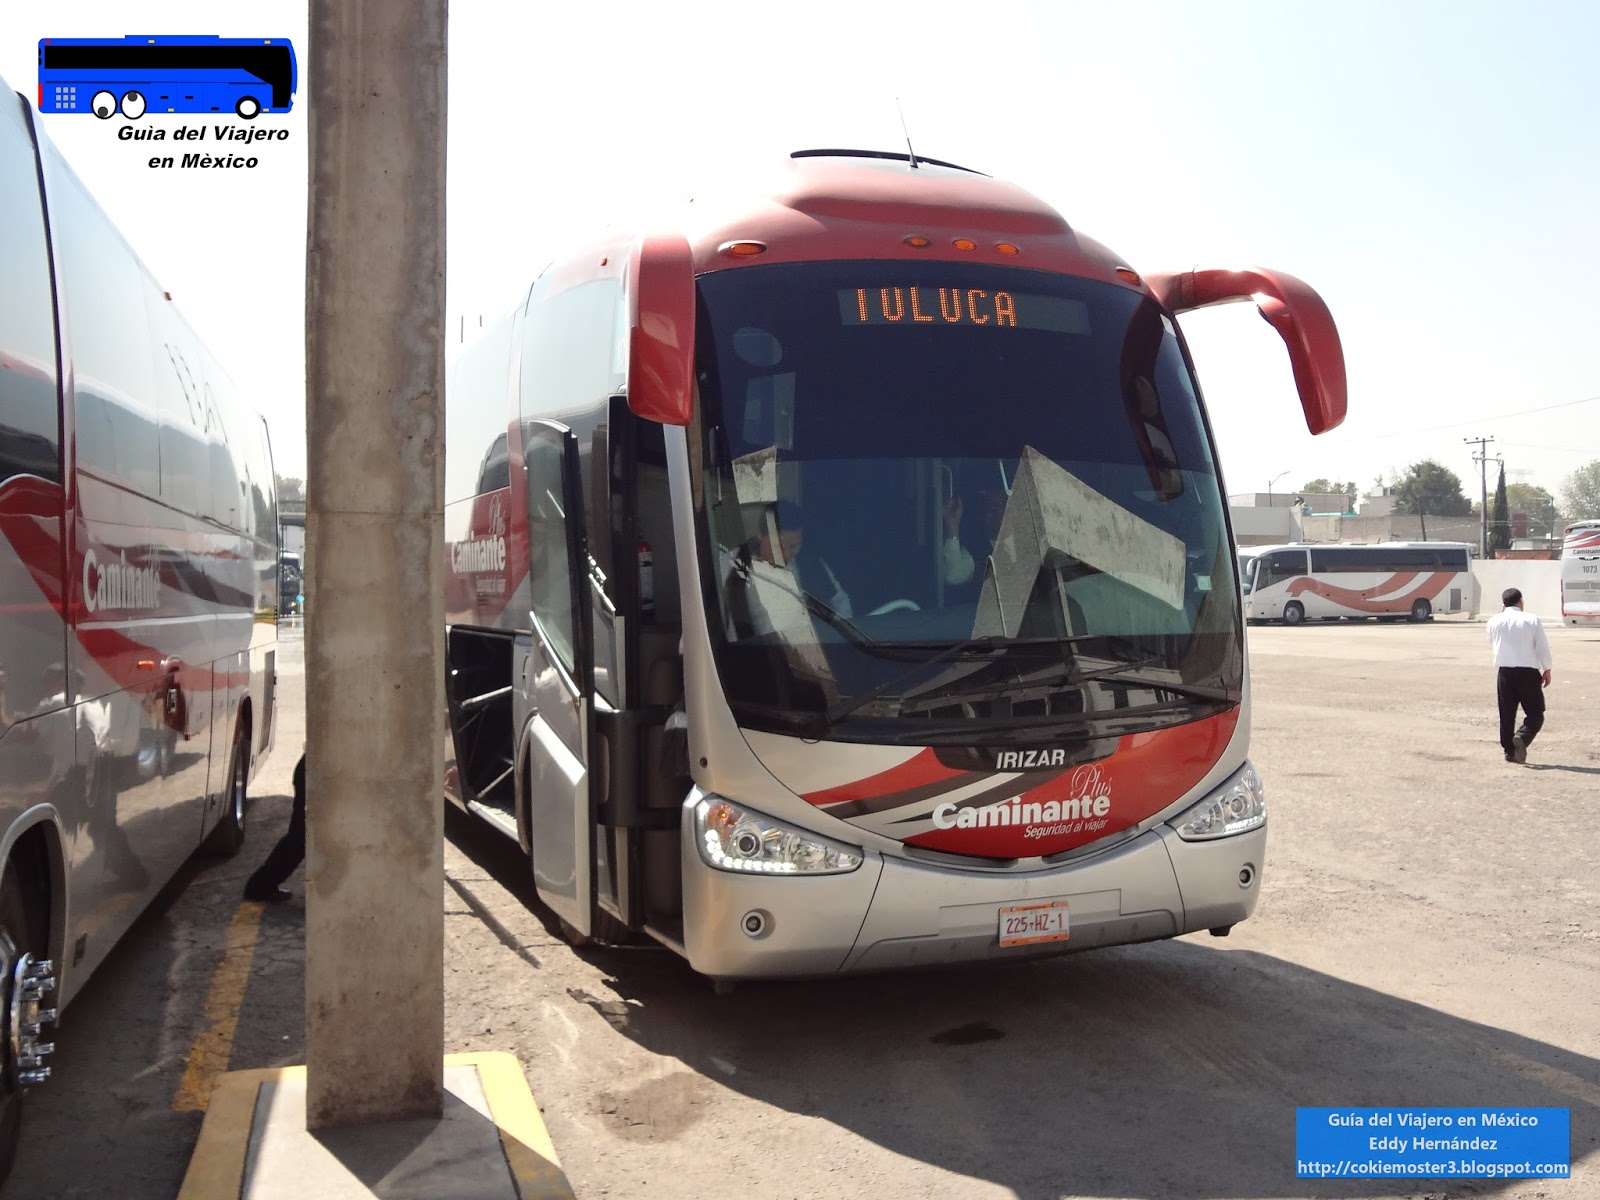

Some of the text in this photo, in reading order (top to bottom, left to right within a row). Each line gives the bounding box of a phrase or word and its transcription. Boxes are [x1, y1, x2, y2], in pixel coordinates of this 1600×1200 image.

[451, 530, 506, 573] Caminante
[83, 549, 161, 613] Caminante
[1582, 565, 1598, 574] 1073
[996, 749, 1066, 770] IRIZAR
[1069, 763, 1112, 799] Plus
[932, 795, 1111, 830] Caminante
[1024, 817, 1109, 840] Seguridad al viajar
